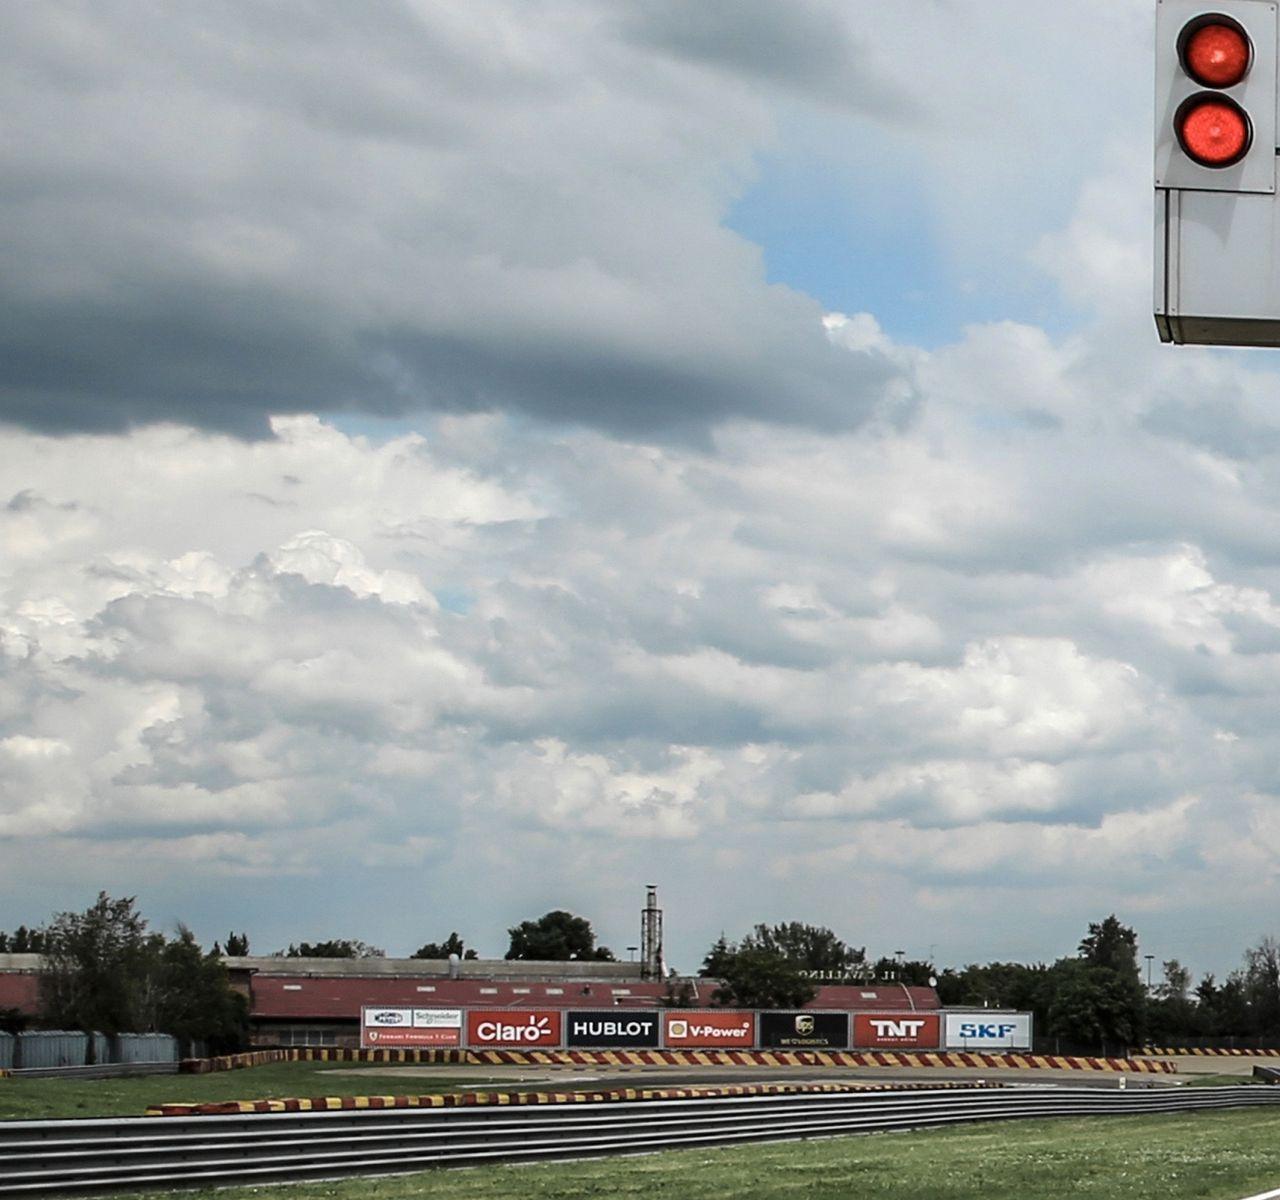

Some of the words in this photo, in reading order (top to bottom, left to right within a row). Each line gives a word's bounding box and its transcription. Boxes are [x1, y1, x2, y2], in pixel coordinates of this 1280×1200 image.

[477, 1022, 541, 1041] Claro
[573, 1022, 653, 1036] HUBLOT
[689, 1026, 748, 1038] V-Power
[869, 1020, 926, 1037] TNT
[959, 1024, 1017, 1039] SKF
